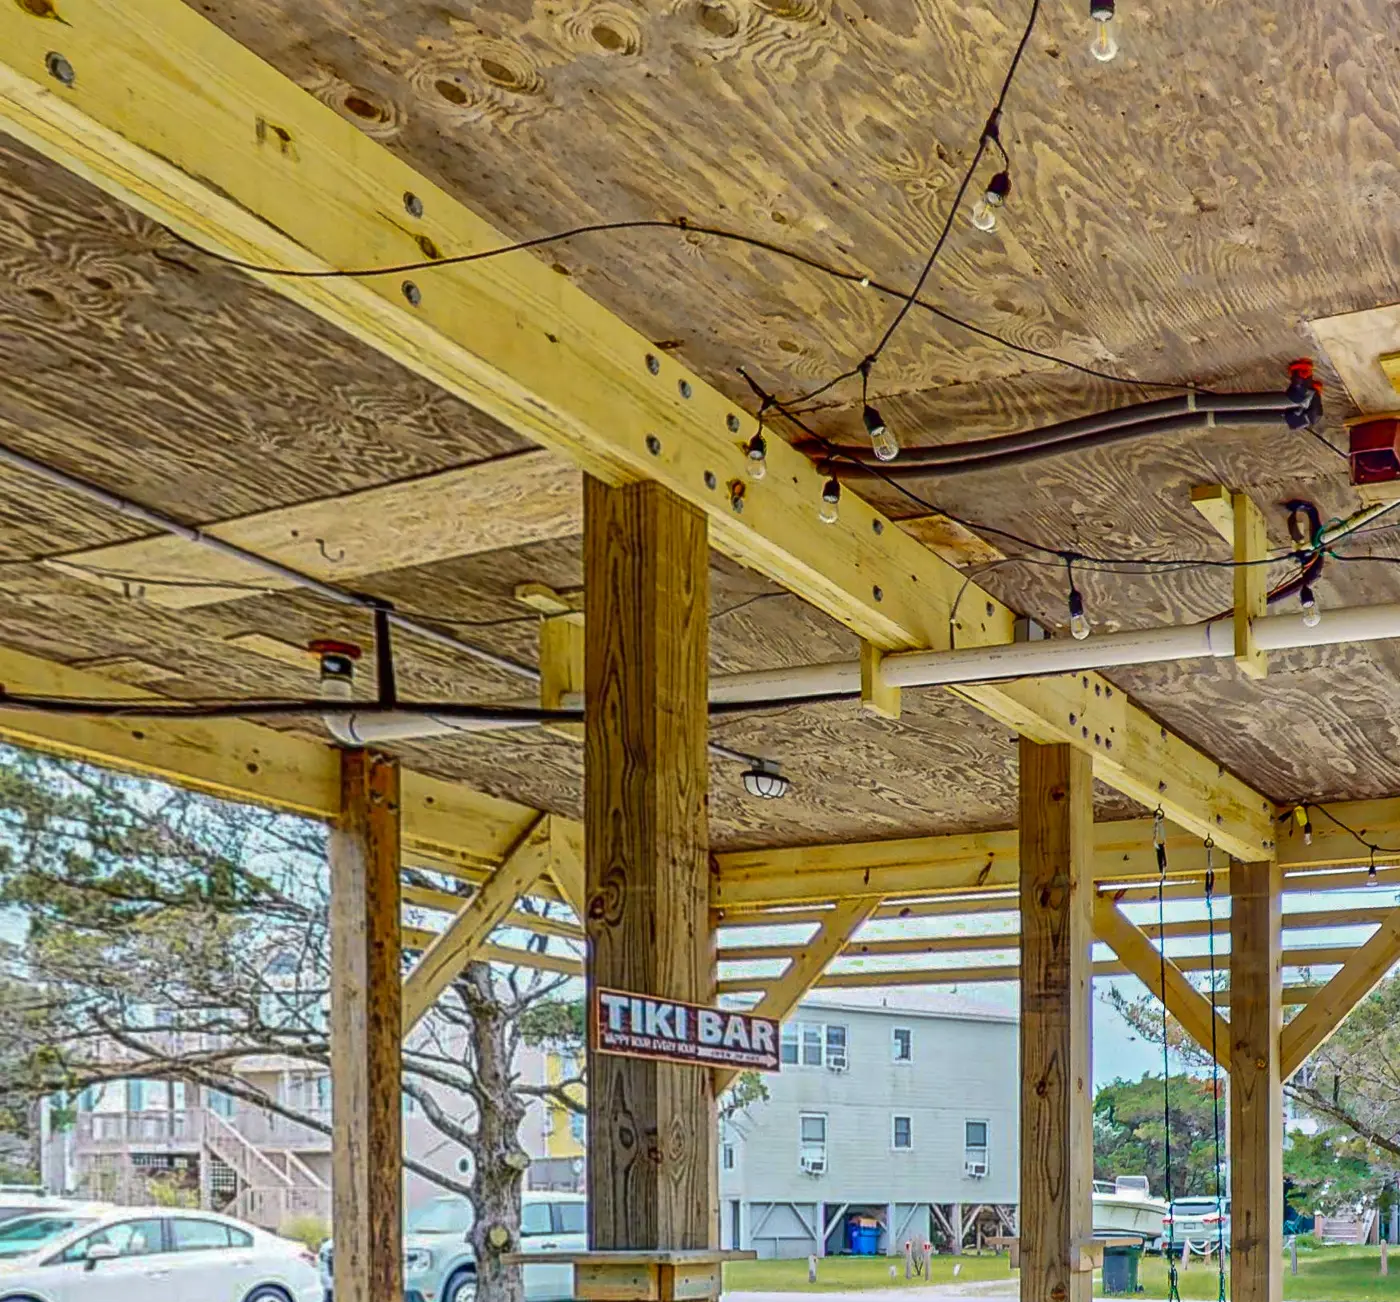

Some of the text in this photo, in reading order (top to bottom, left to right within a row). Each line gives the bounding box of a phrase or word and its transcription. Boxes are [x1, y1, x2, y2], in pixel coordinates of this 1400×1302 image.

[601, 993, 776, 1052] TIKI BAR
[631, 1035, 651, 1048] HOUR
[653, 1039, 676, 1051] EVERY
[678, 1042, 697, 1054] HOUR
